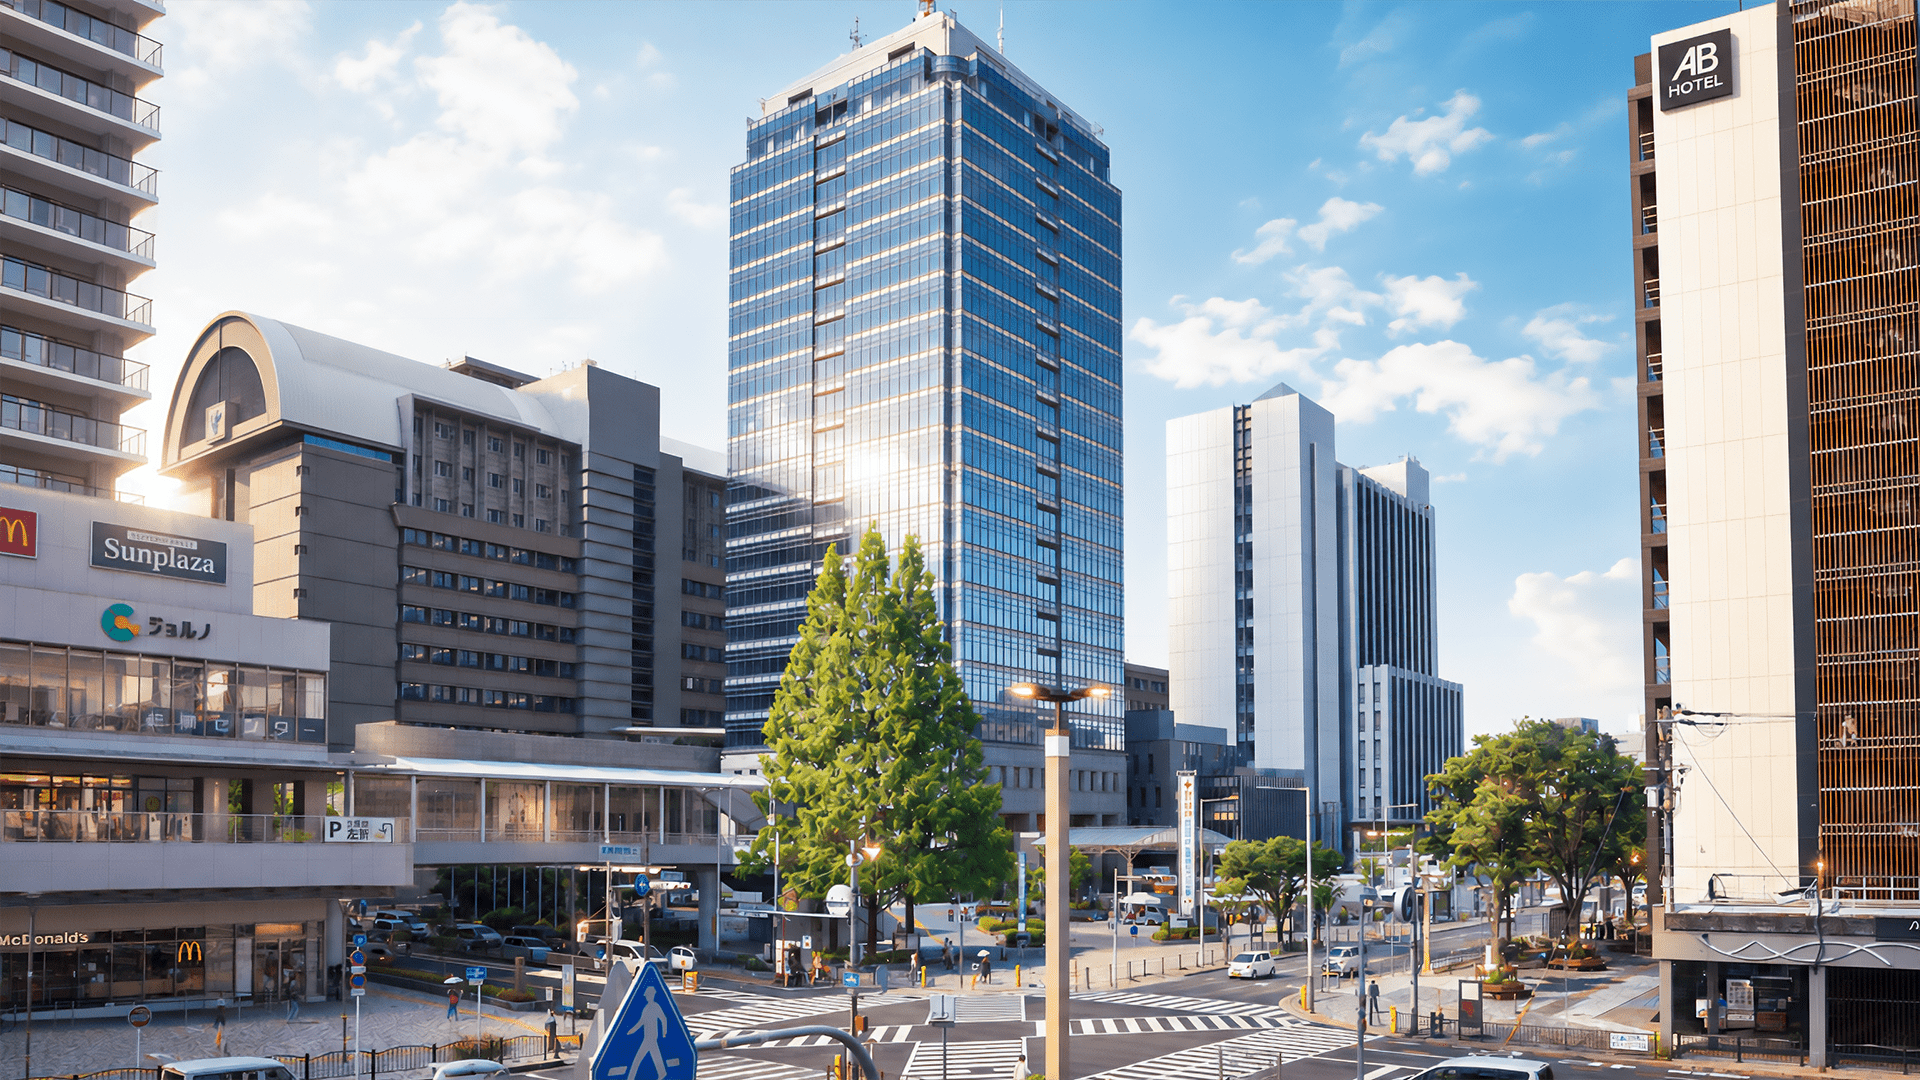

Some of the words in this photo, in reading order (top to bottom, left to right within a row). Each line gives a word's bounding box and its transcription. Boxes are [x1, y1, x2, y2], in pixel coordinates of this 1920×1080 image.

[1671, 42, 1719, 81] AB
[1668, 74, 1723, 98] HOTEL
[104, 537, 215, 573] Sunplaza
[148, 616, 211, 640] ジョルノ
[329, 821, 342, 838] P
[0, 931, 89, 946] McDonald's
